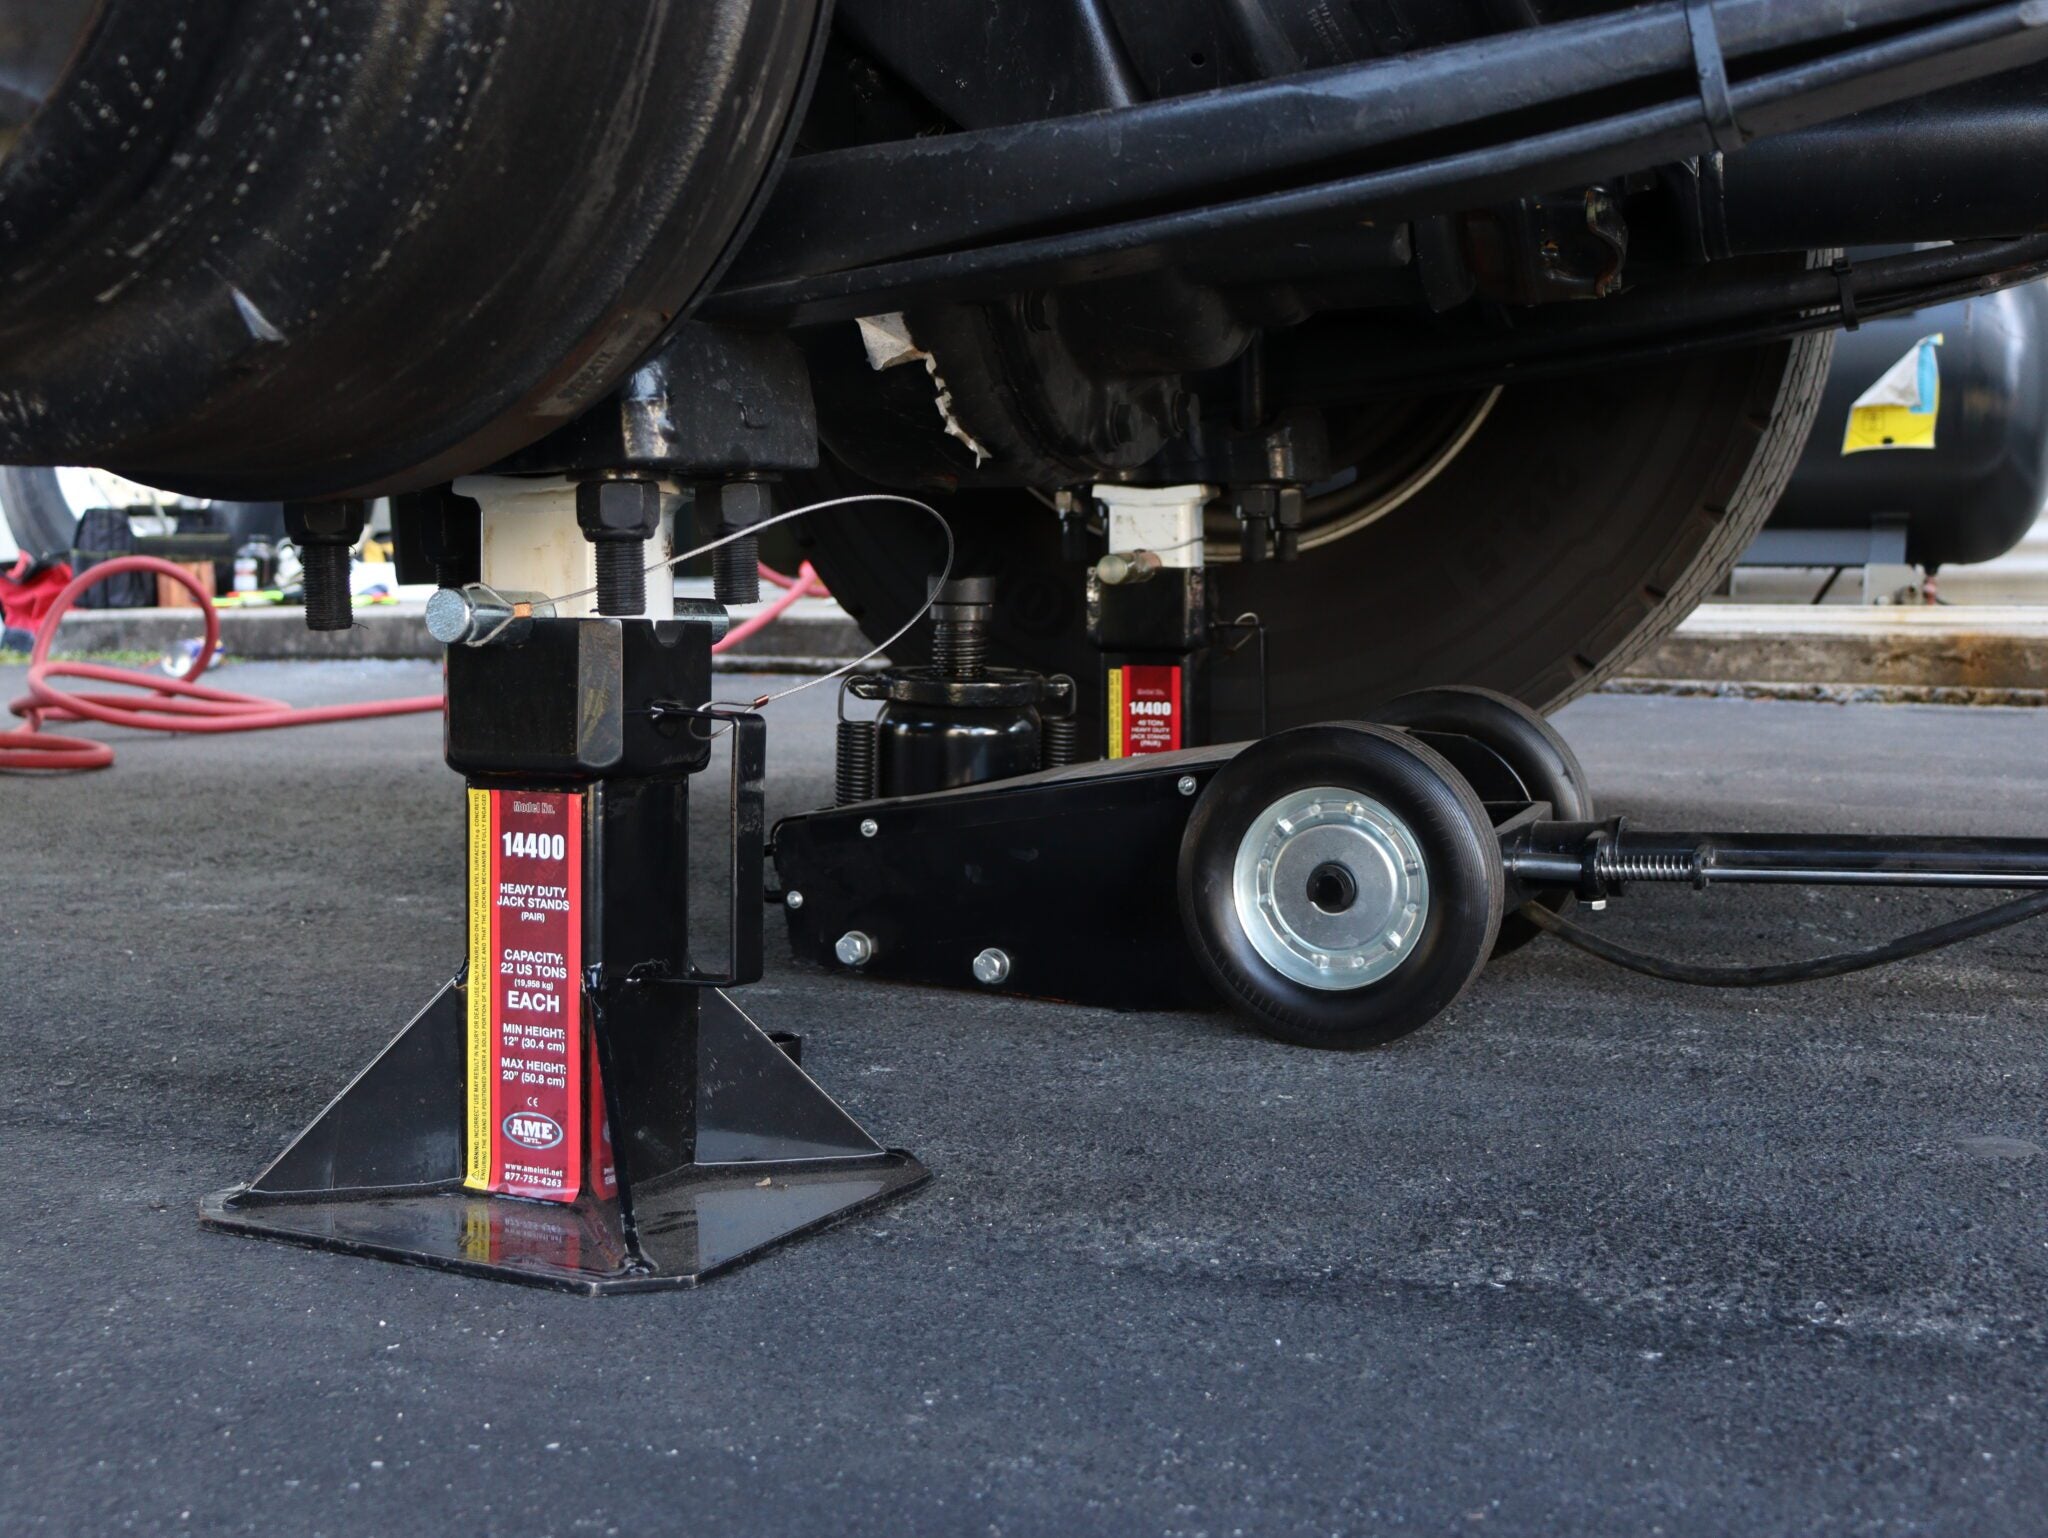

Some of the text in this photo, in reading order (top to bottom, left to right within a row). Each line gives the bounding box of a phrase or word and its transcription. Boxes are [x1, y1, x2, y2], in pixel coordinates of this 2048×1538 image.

[1129, 702, 1171, 716] 14400
[514, 801, 539, 813] Model
[503, 832, 564, 860] 14400
[500, 883, 566, 897] HEAVY DUTY
[497, 895, 569, 911] JACK STANDS
[521, 912, 545, 923] (PAIR)
[474, 924, 479, 932] ON
[504, 949, 563, 965] CAPACITY:
[501, 963, 567, 979] 22 US TONS
[514, 978, 553, 991] (19,958 kg)
[508, 990, 559, 1013] EACH
[474, 1020, 479, 1029] OR
[503, 1023, 565, 1039] MIN HEIGHT:
[521, 1038, 544, 1050] (30.4
[547, 1042, 565, 1053] cm)
[501, 1057, 566, 1075] MAX HEIGHT:
[521, 1073, 544, 1085] (50.8
[547, 1077, 565, 1089] cm)
[511, 1118, 553, 1140] AME
[505, 1162, 563, 1177] www.ameintl.net
[505, 1172, 562, 1188] 877-755-4263
